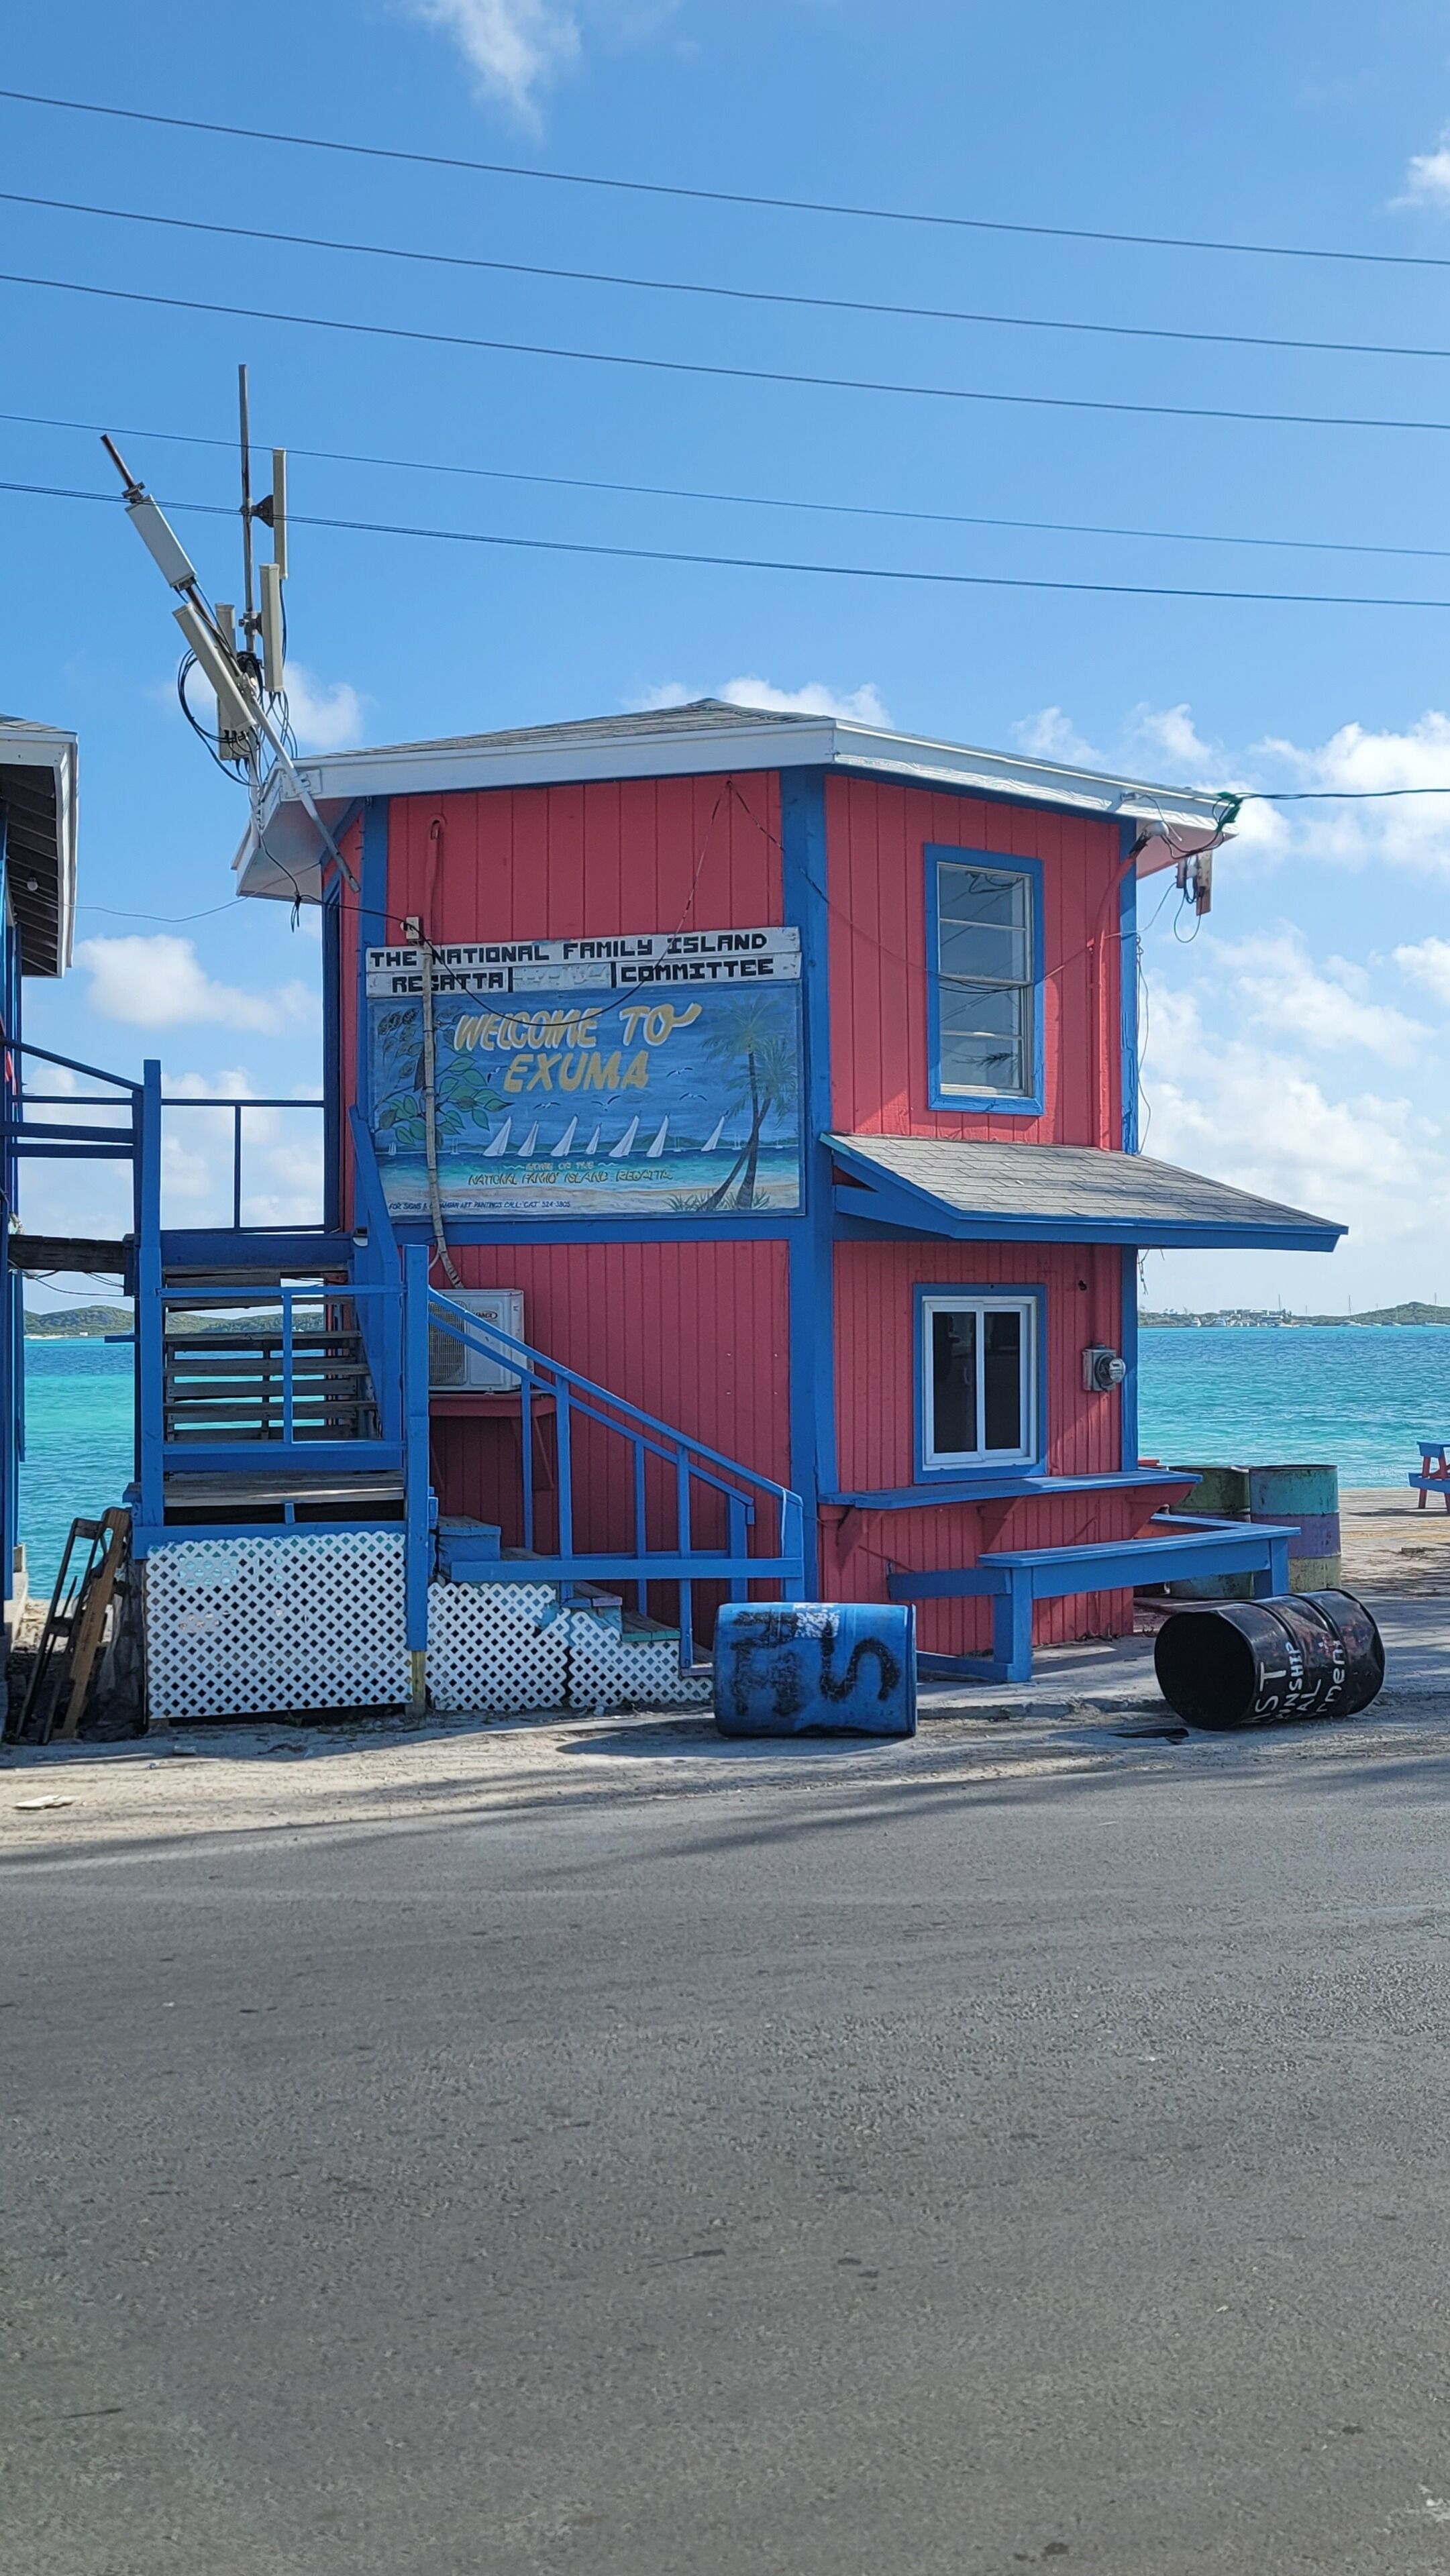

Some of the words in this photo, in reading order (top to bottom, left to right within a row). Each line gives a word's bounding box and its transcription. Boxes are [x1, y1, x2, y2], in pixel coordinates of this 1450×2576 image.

[370, 950, 417, 967] THE
[431, 945, 550, 965] NATIONAL
[562, 938, 653, 960] FAMILY
[666, 932, 768, 955] ISLAND
[620, 958, 774, 983] COMMITTEE
[453, 1008, 602, 1052] WELCOME
[619, 1002, 703, 1047] TO
[503, 1049, 650, 1093] EXUMA
[468, 1173, 518, 1185] NATIONAL
[564, 1171, 609, 1184] ISLAND
[615, 1169, 674, 1182] REGATTA
